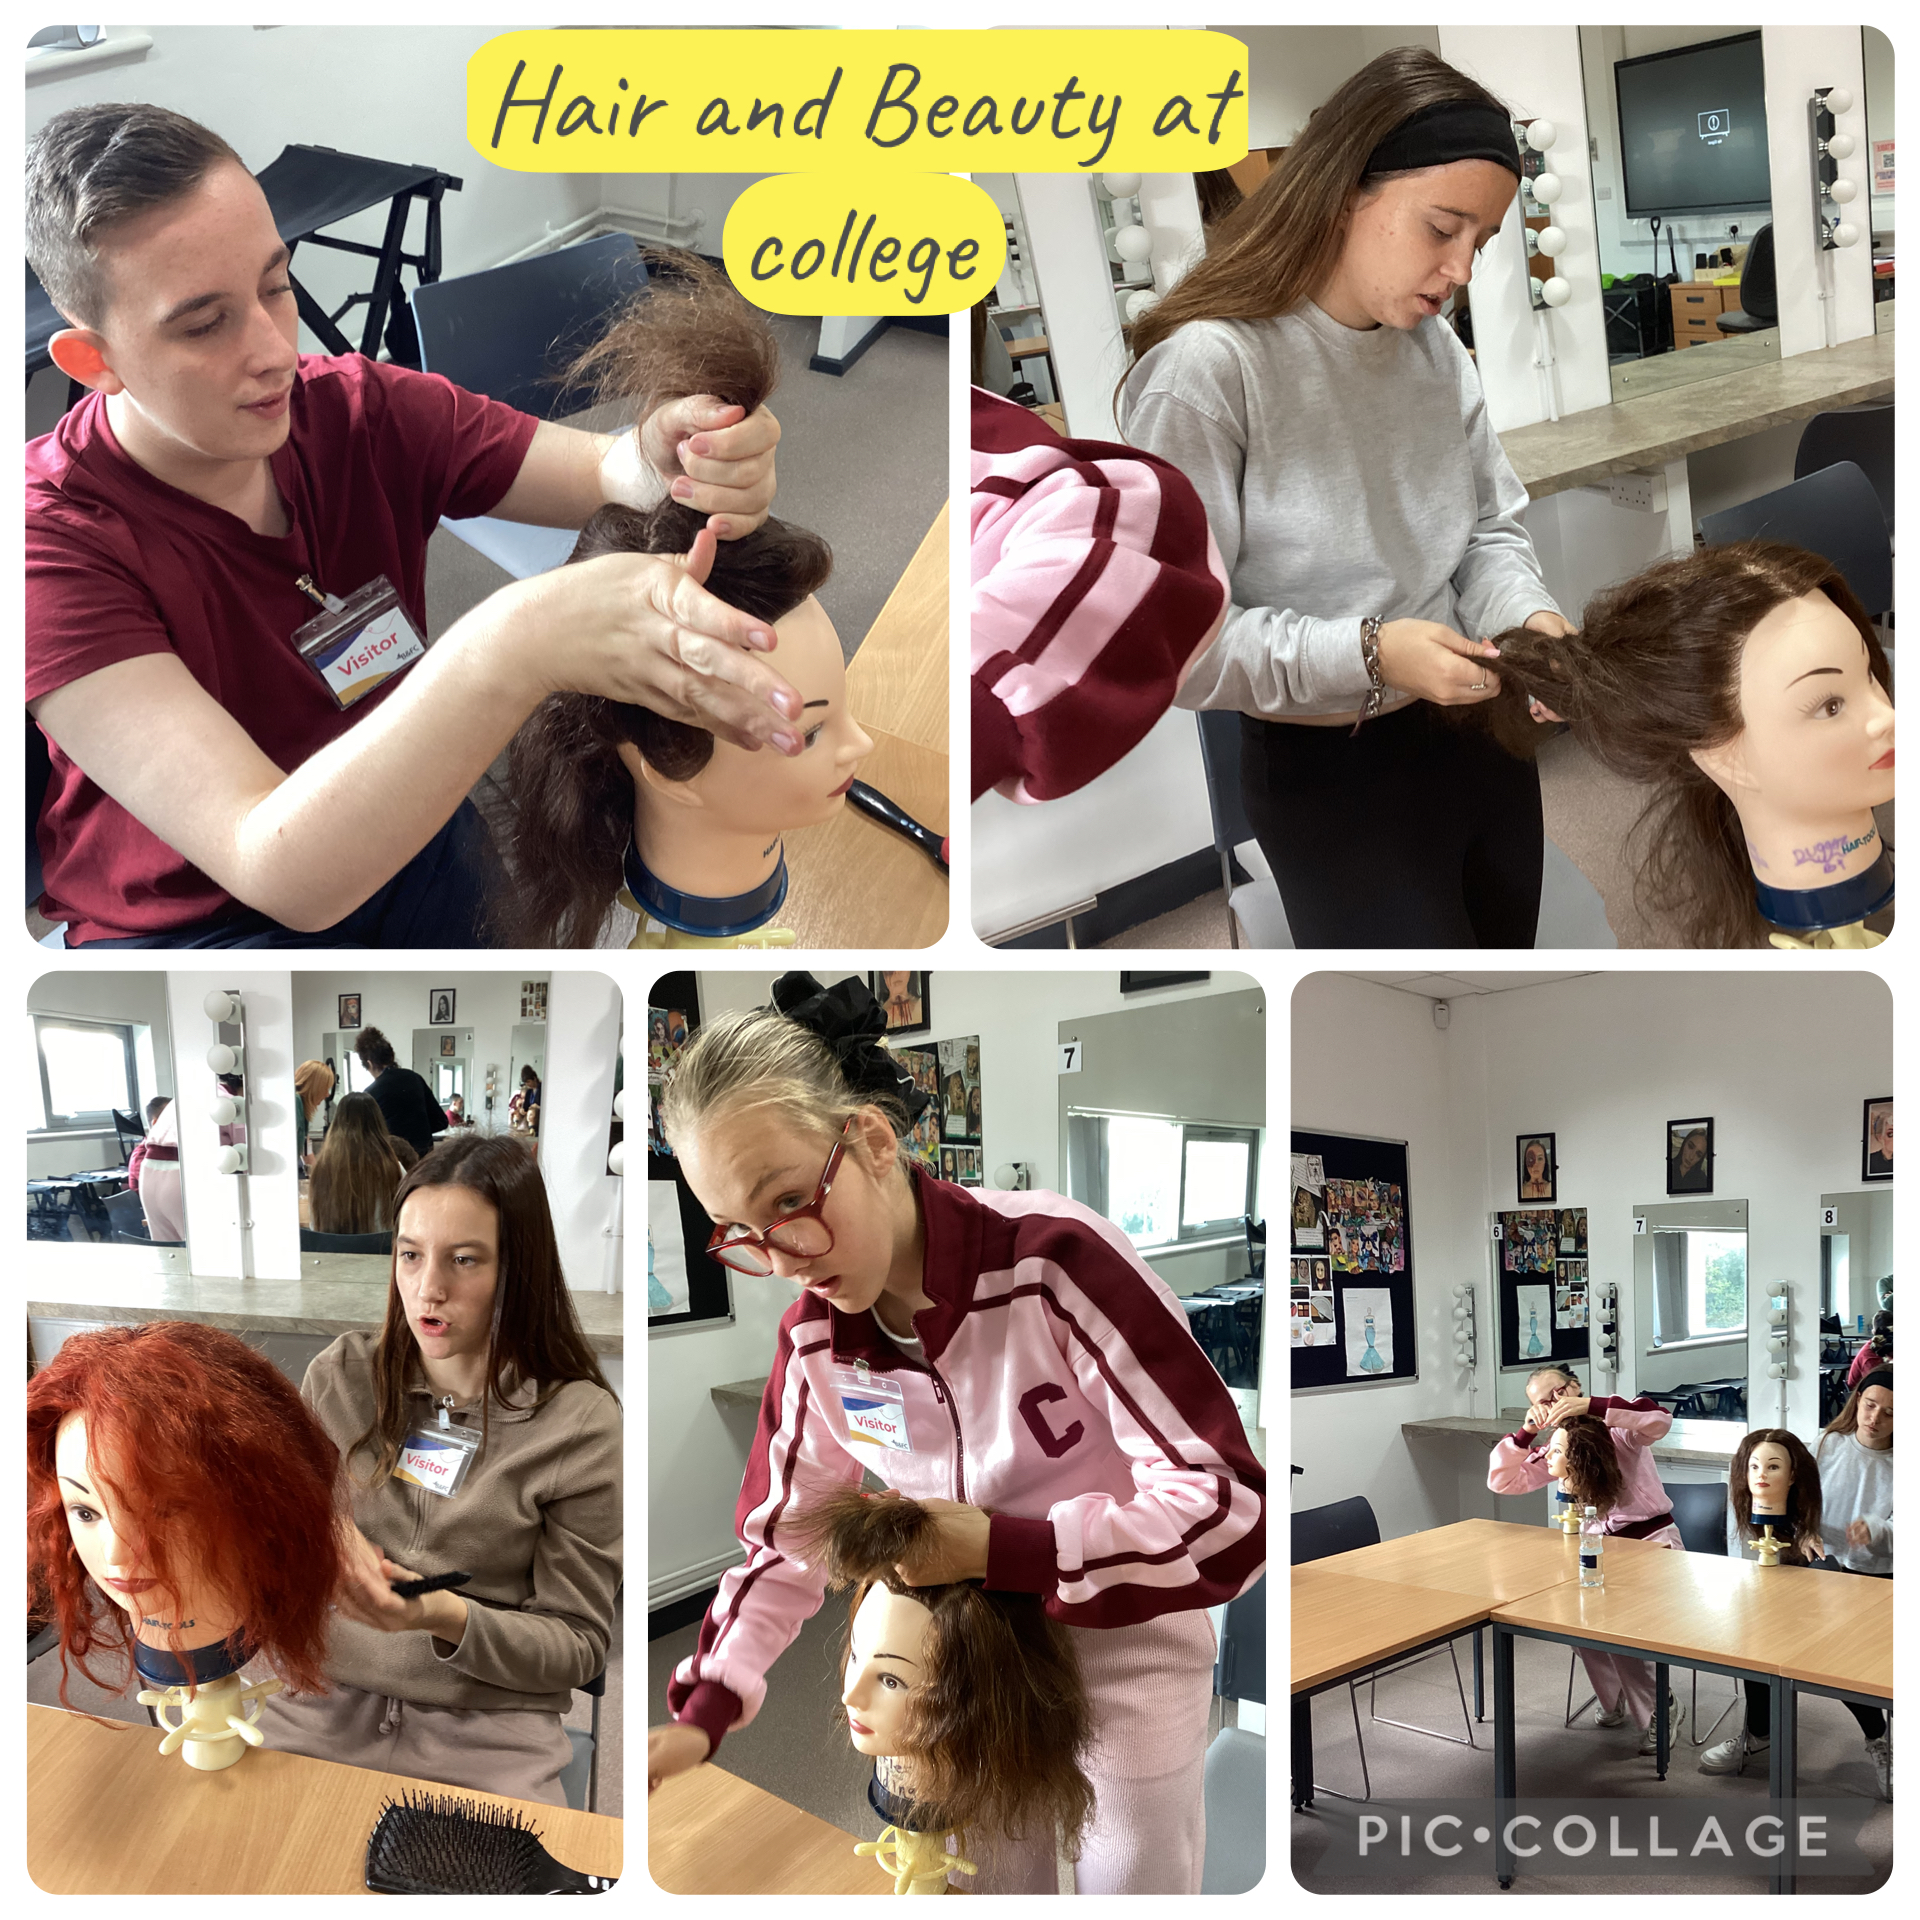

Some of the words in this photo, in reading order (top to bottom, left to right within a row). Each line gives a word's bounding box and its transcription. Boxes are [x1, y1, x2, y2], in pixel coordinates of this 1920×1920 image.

[337, 632, 398, 676] Visitor
[1063, 1047, 1076, 1069] 7
[1635, 1218, 1644, 1233] 7
[1824, 1209, 1834, 1224] 8
[1493, 1226, 1500, 1238] 6
[853, 1415, 897, 1434] Visitor
[1018, 1382, 1085, 1458] C
[406, 1453, 449, 1476] Visitor
